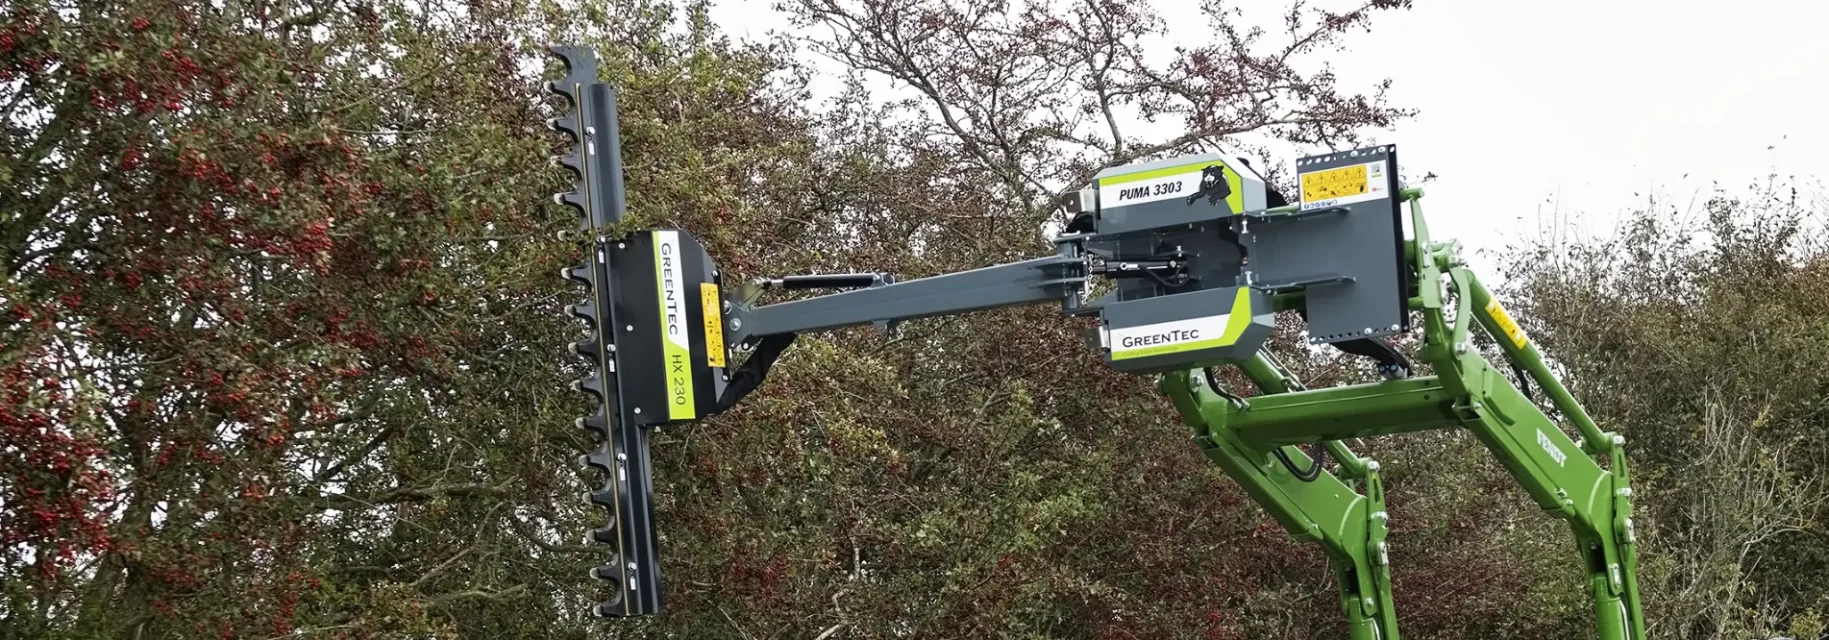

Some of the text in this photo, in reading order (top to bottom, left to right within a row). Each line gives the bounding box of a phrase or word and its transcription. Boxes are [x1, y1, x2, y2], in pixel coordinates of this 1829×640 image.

[1119, 181, 1183, 201] PUMA 3303
[672, 354, 686, 405] HX 230
[1536, 427, 1567, 468] FENDT
